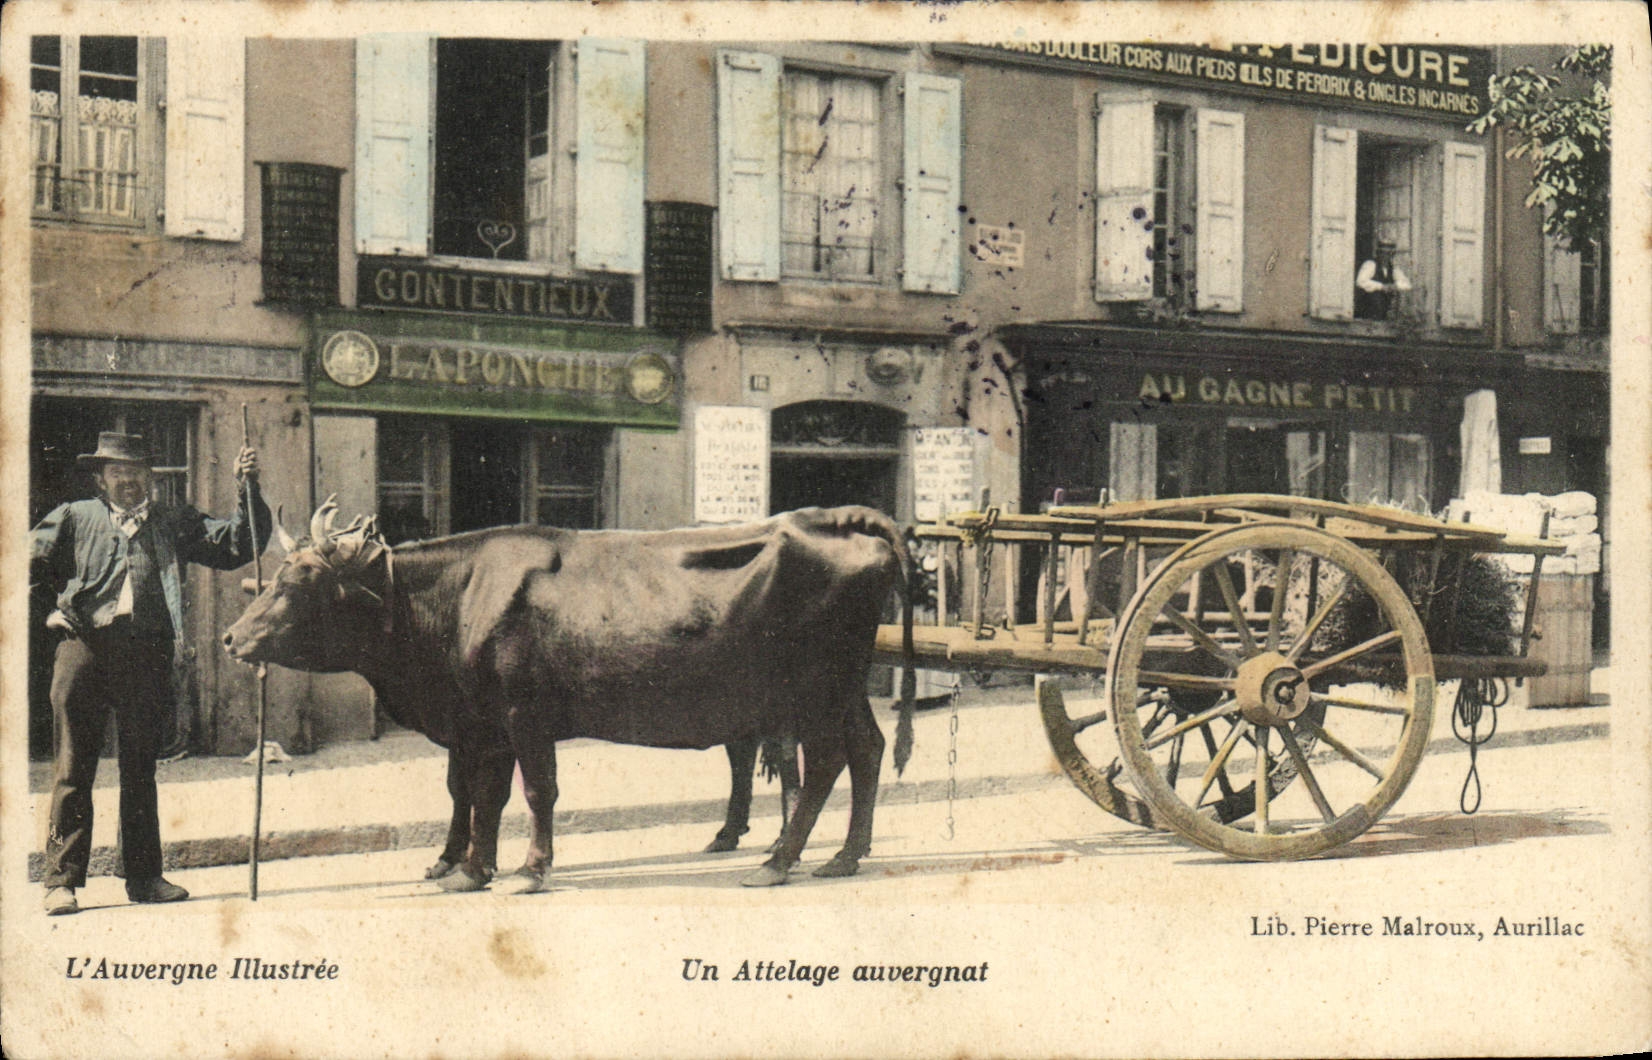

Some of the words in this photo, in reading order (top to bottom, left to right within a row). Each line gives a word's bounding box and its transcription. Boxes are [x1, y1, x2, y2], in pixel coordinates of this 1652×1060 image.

[1045, 42, 1120, 65] DOULEUR
[1124, 46, 1163, 71] CORS
[1165, 52, 1193, 75] AUX
[1196, 56, 1236, 81] PIEDS
[1275, 67, 1293, 90] DE
[1297, 71, 1351, 98] PERDRIX
[1353, 80, 1366, 100] &
[1138, 373, 1187, 401] AU
[1197, 376, 1314, 408] GAGNE
[1324, 384, 1416, 413] PETIT
